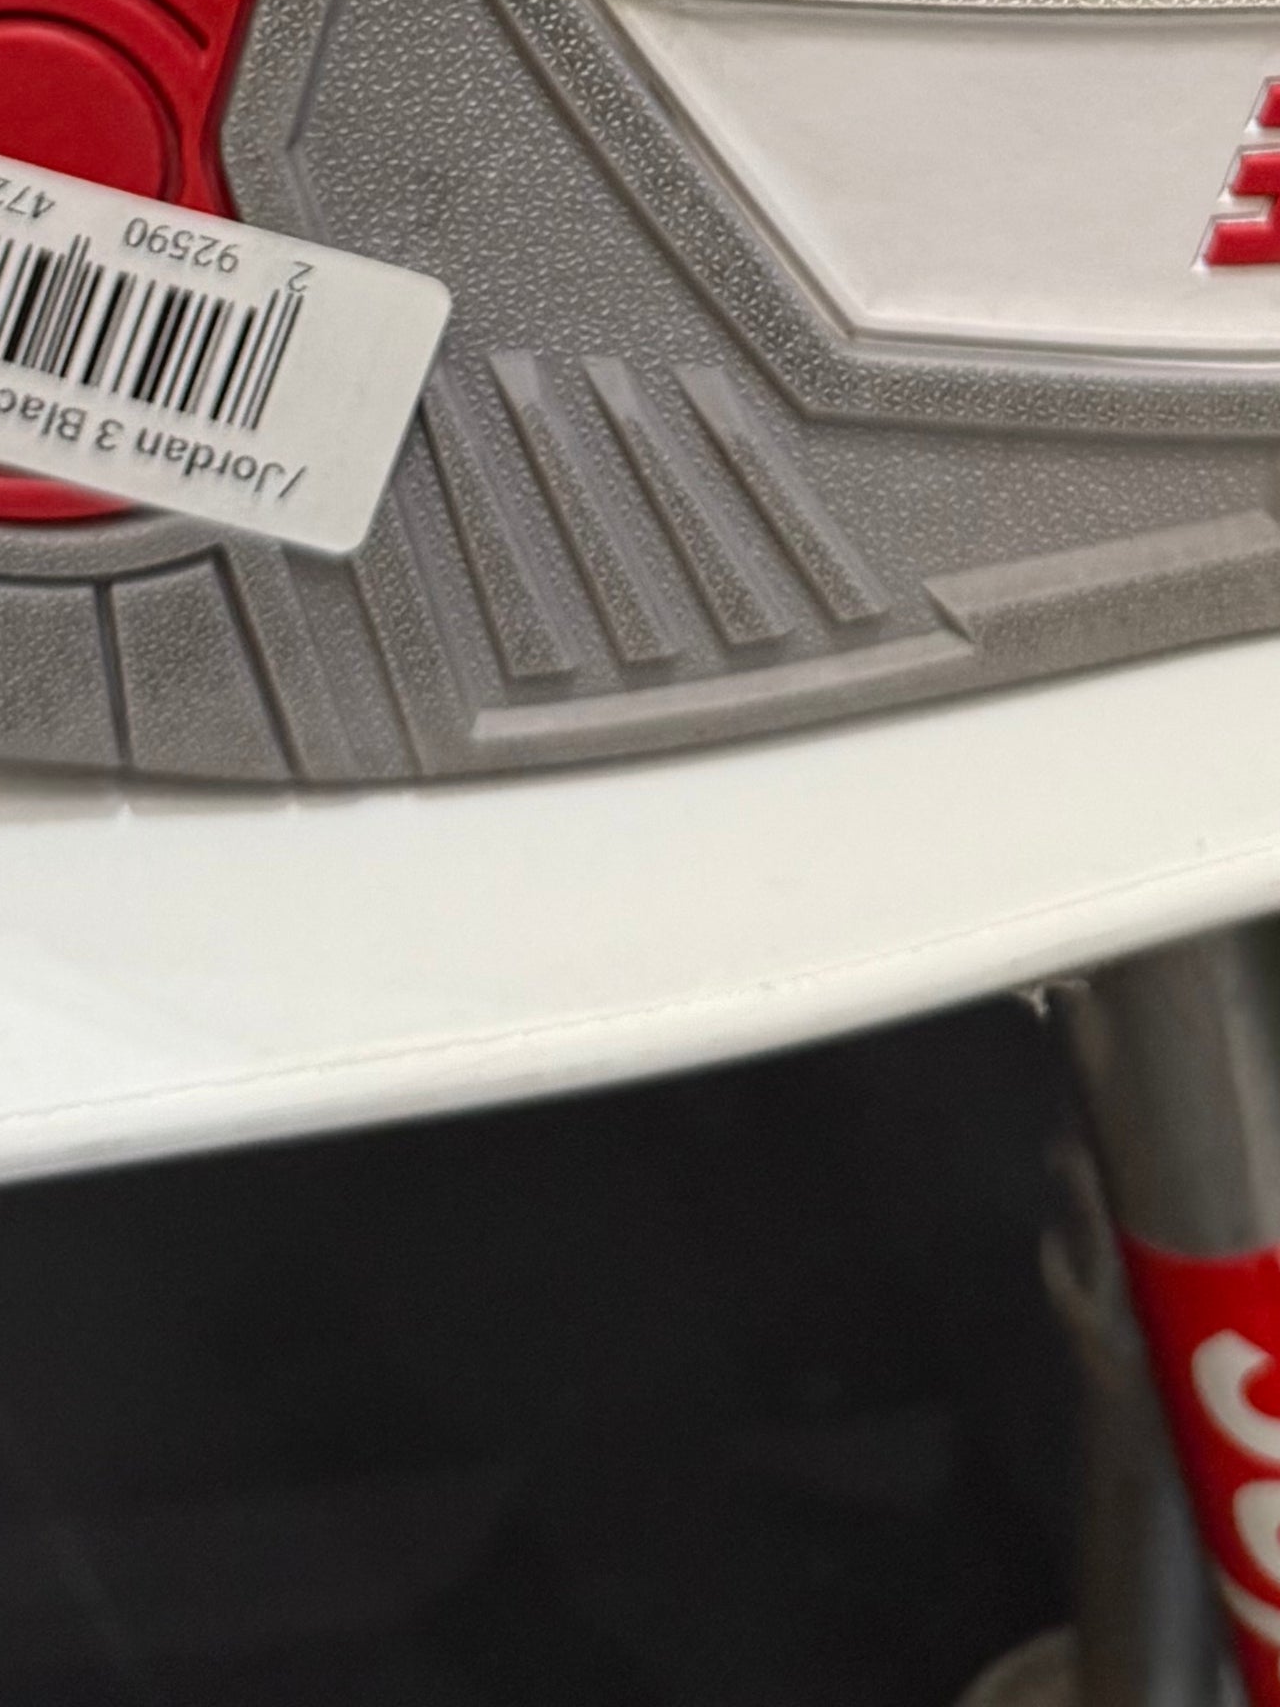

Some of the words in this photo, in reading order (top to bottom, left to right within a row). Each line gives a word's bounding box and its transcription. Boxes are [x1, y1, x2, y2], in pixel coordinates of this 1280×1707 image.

[122, 217, 239, 274] 92590
[287, 260, 316, 293] 2
[94, 418, 124, 453] 3
